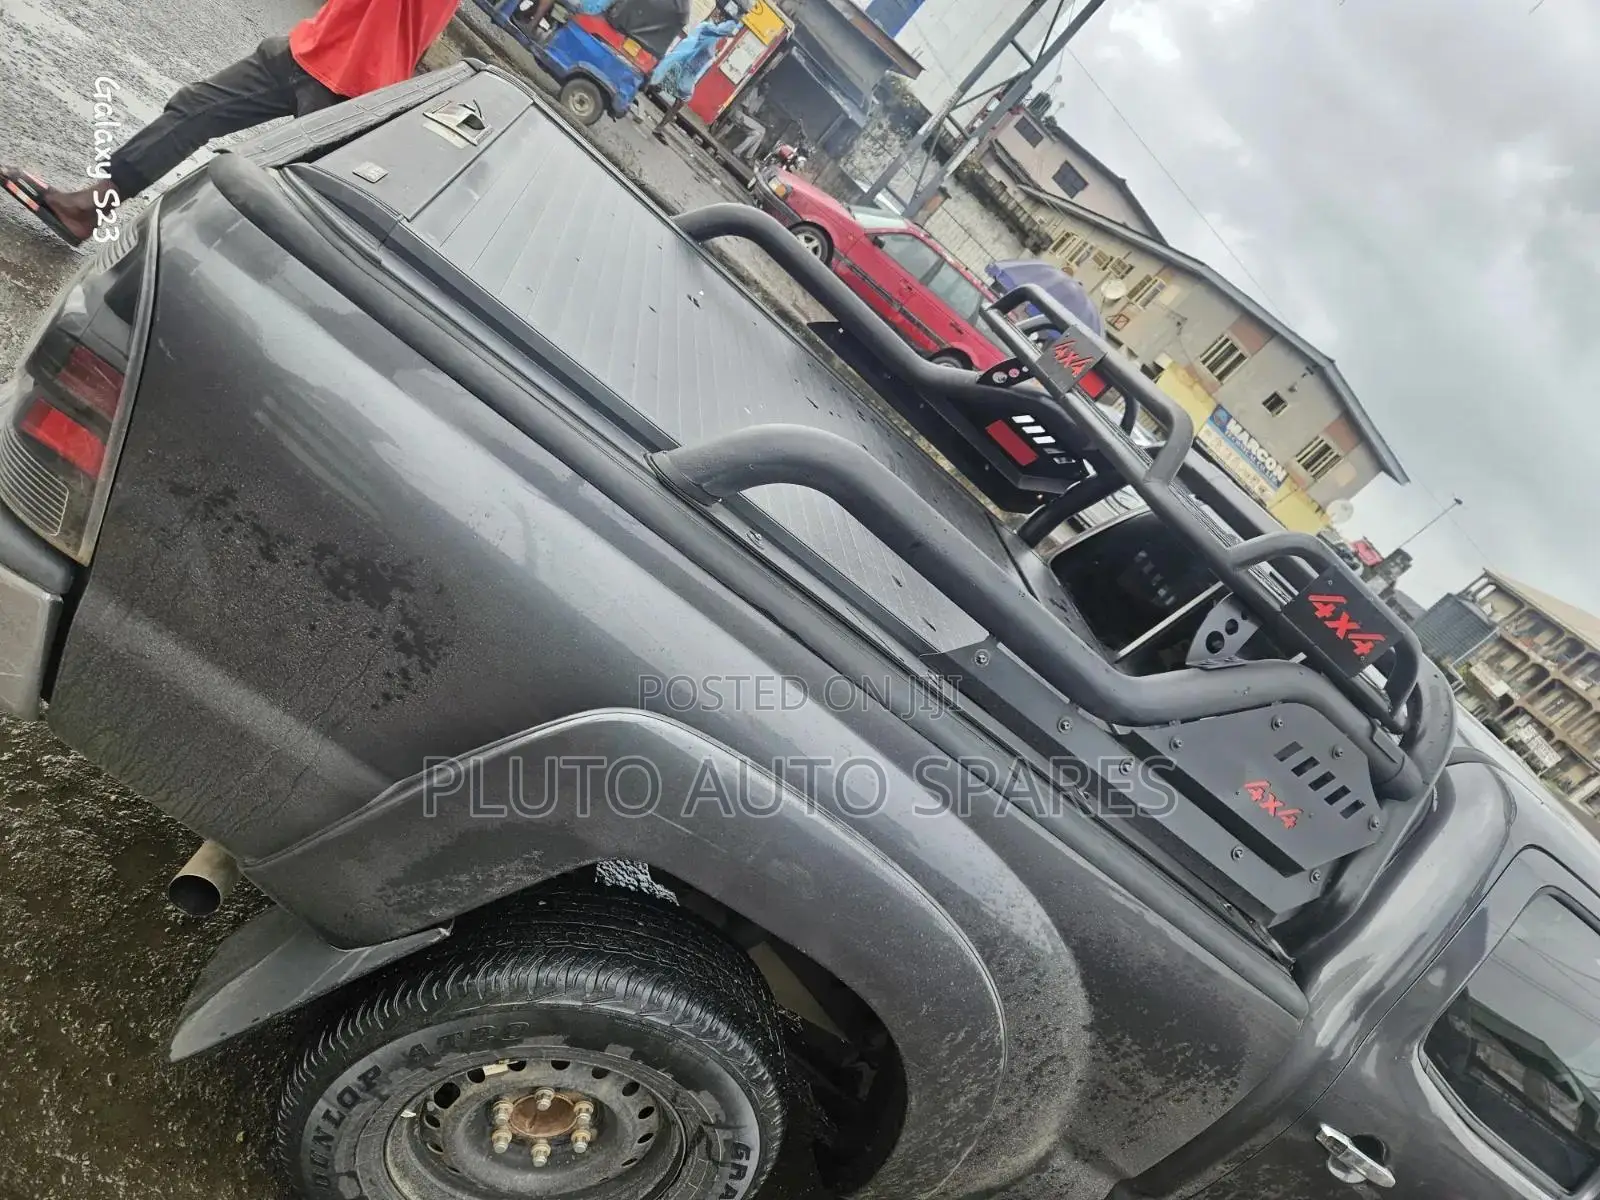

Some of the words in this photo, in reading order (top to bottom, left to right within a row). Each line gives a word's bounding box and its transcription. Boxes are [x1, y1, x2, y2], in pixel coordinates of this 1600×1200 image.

[1308, 594, 1386, 656] 4x4
[1244, 780, 1304, 830] 4x4
[309, 1064, 382, 1192] DUNLOP
